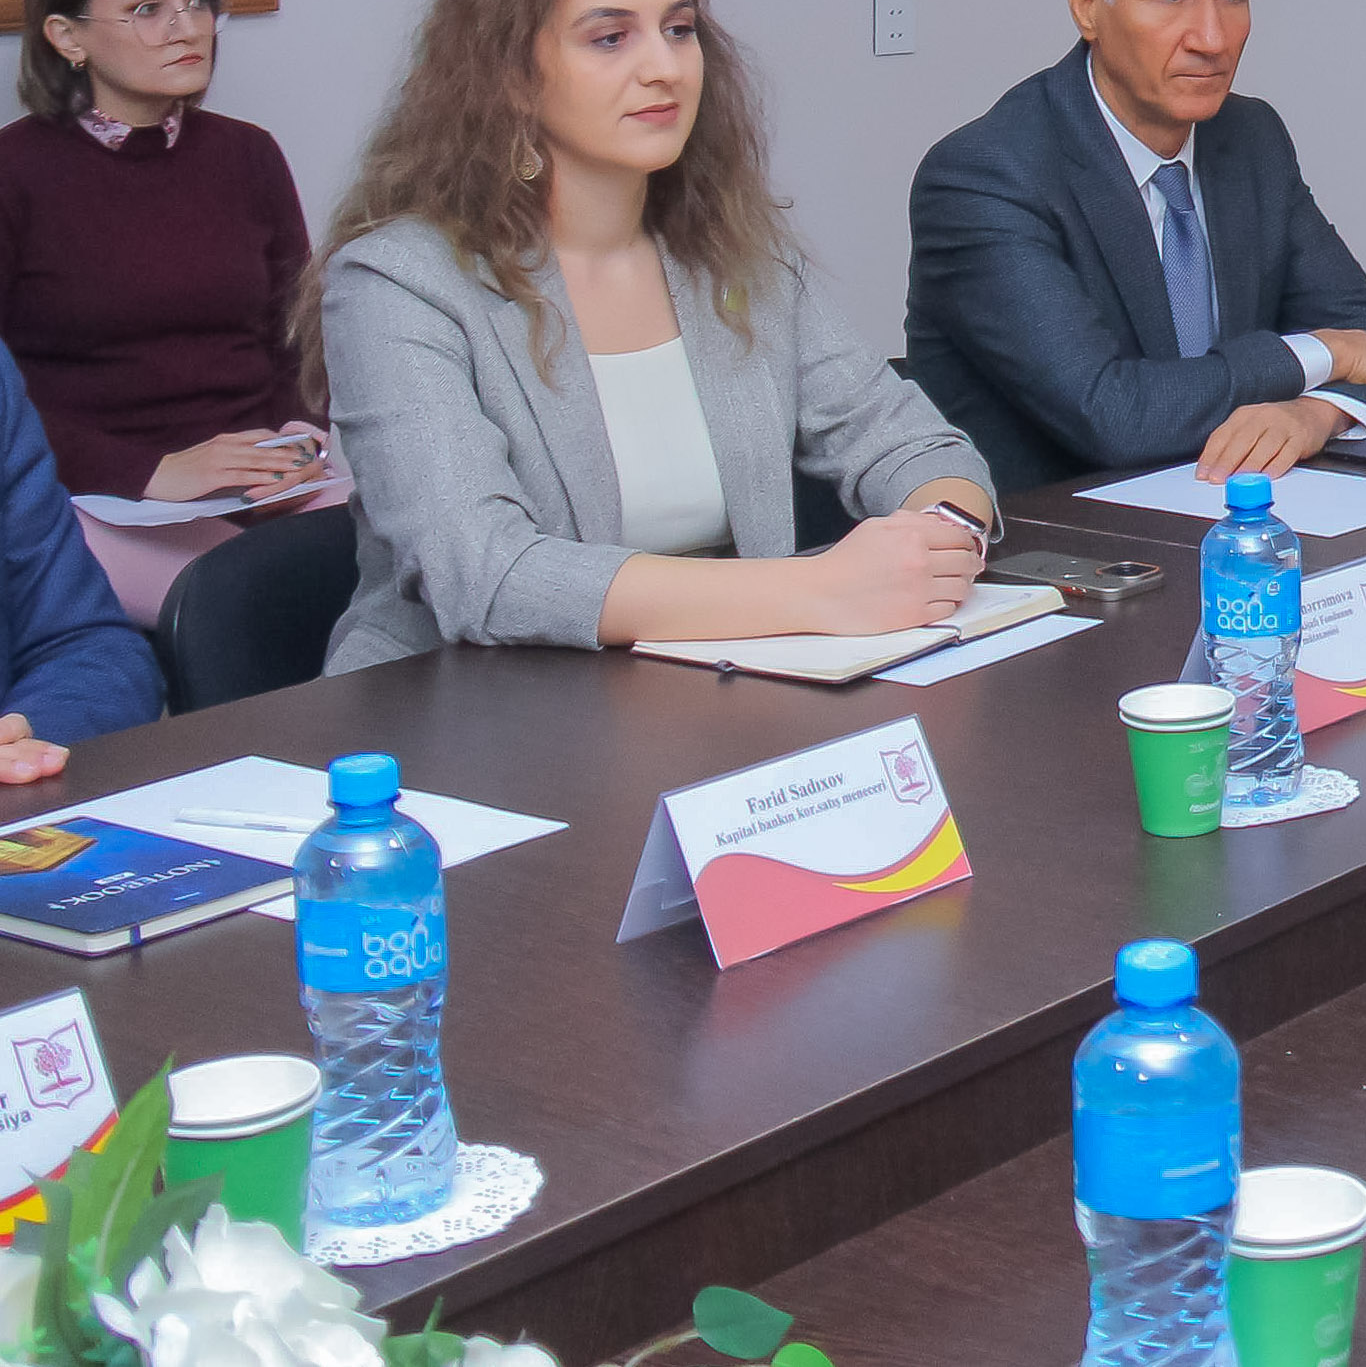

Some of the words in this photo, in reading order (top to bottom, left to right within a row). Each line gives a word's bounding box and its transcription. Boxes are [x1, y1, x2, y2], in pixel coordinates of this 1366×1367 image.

[1217, 593, 1263, 614] bon
[1217, 613, 1278, 633] aqua
[745, 789, 787, 815] Fərid
[788, 772, 845, 802] Sadıxov
[61, 861, 210, 905] NOTEBOOK
[364, 941, 442, 979] aqua
